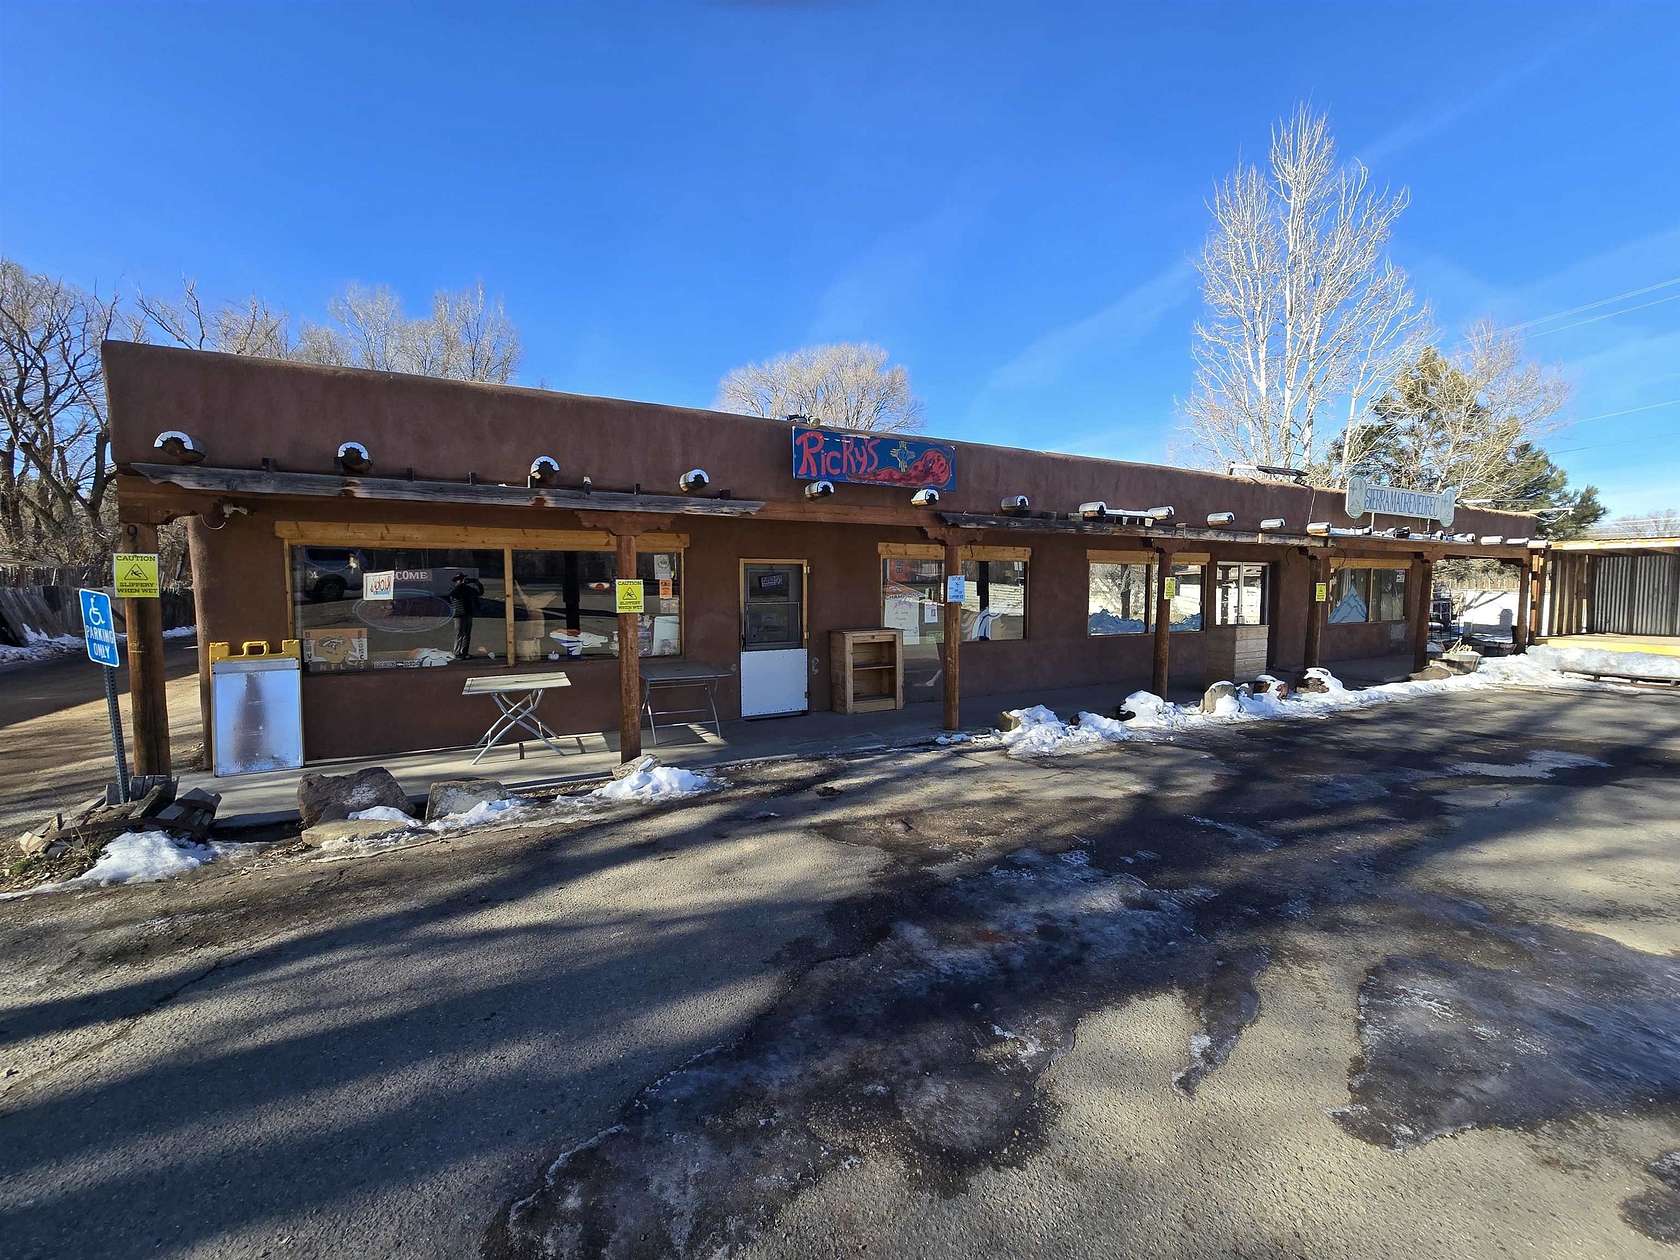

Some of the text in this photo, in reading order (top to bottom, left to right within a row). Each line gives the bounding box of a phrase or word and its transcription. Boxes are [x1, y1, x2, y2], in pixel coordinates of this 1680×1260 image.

[115, 554, 156, 562] CAUTION
[395, 570, 429, 580] COME
[85, 625, 115, 644] PARKING
[92, 642, 111, 660] ONLY
